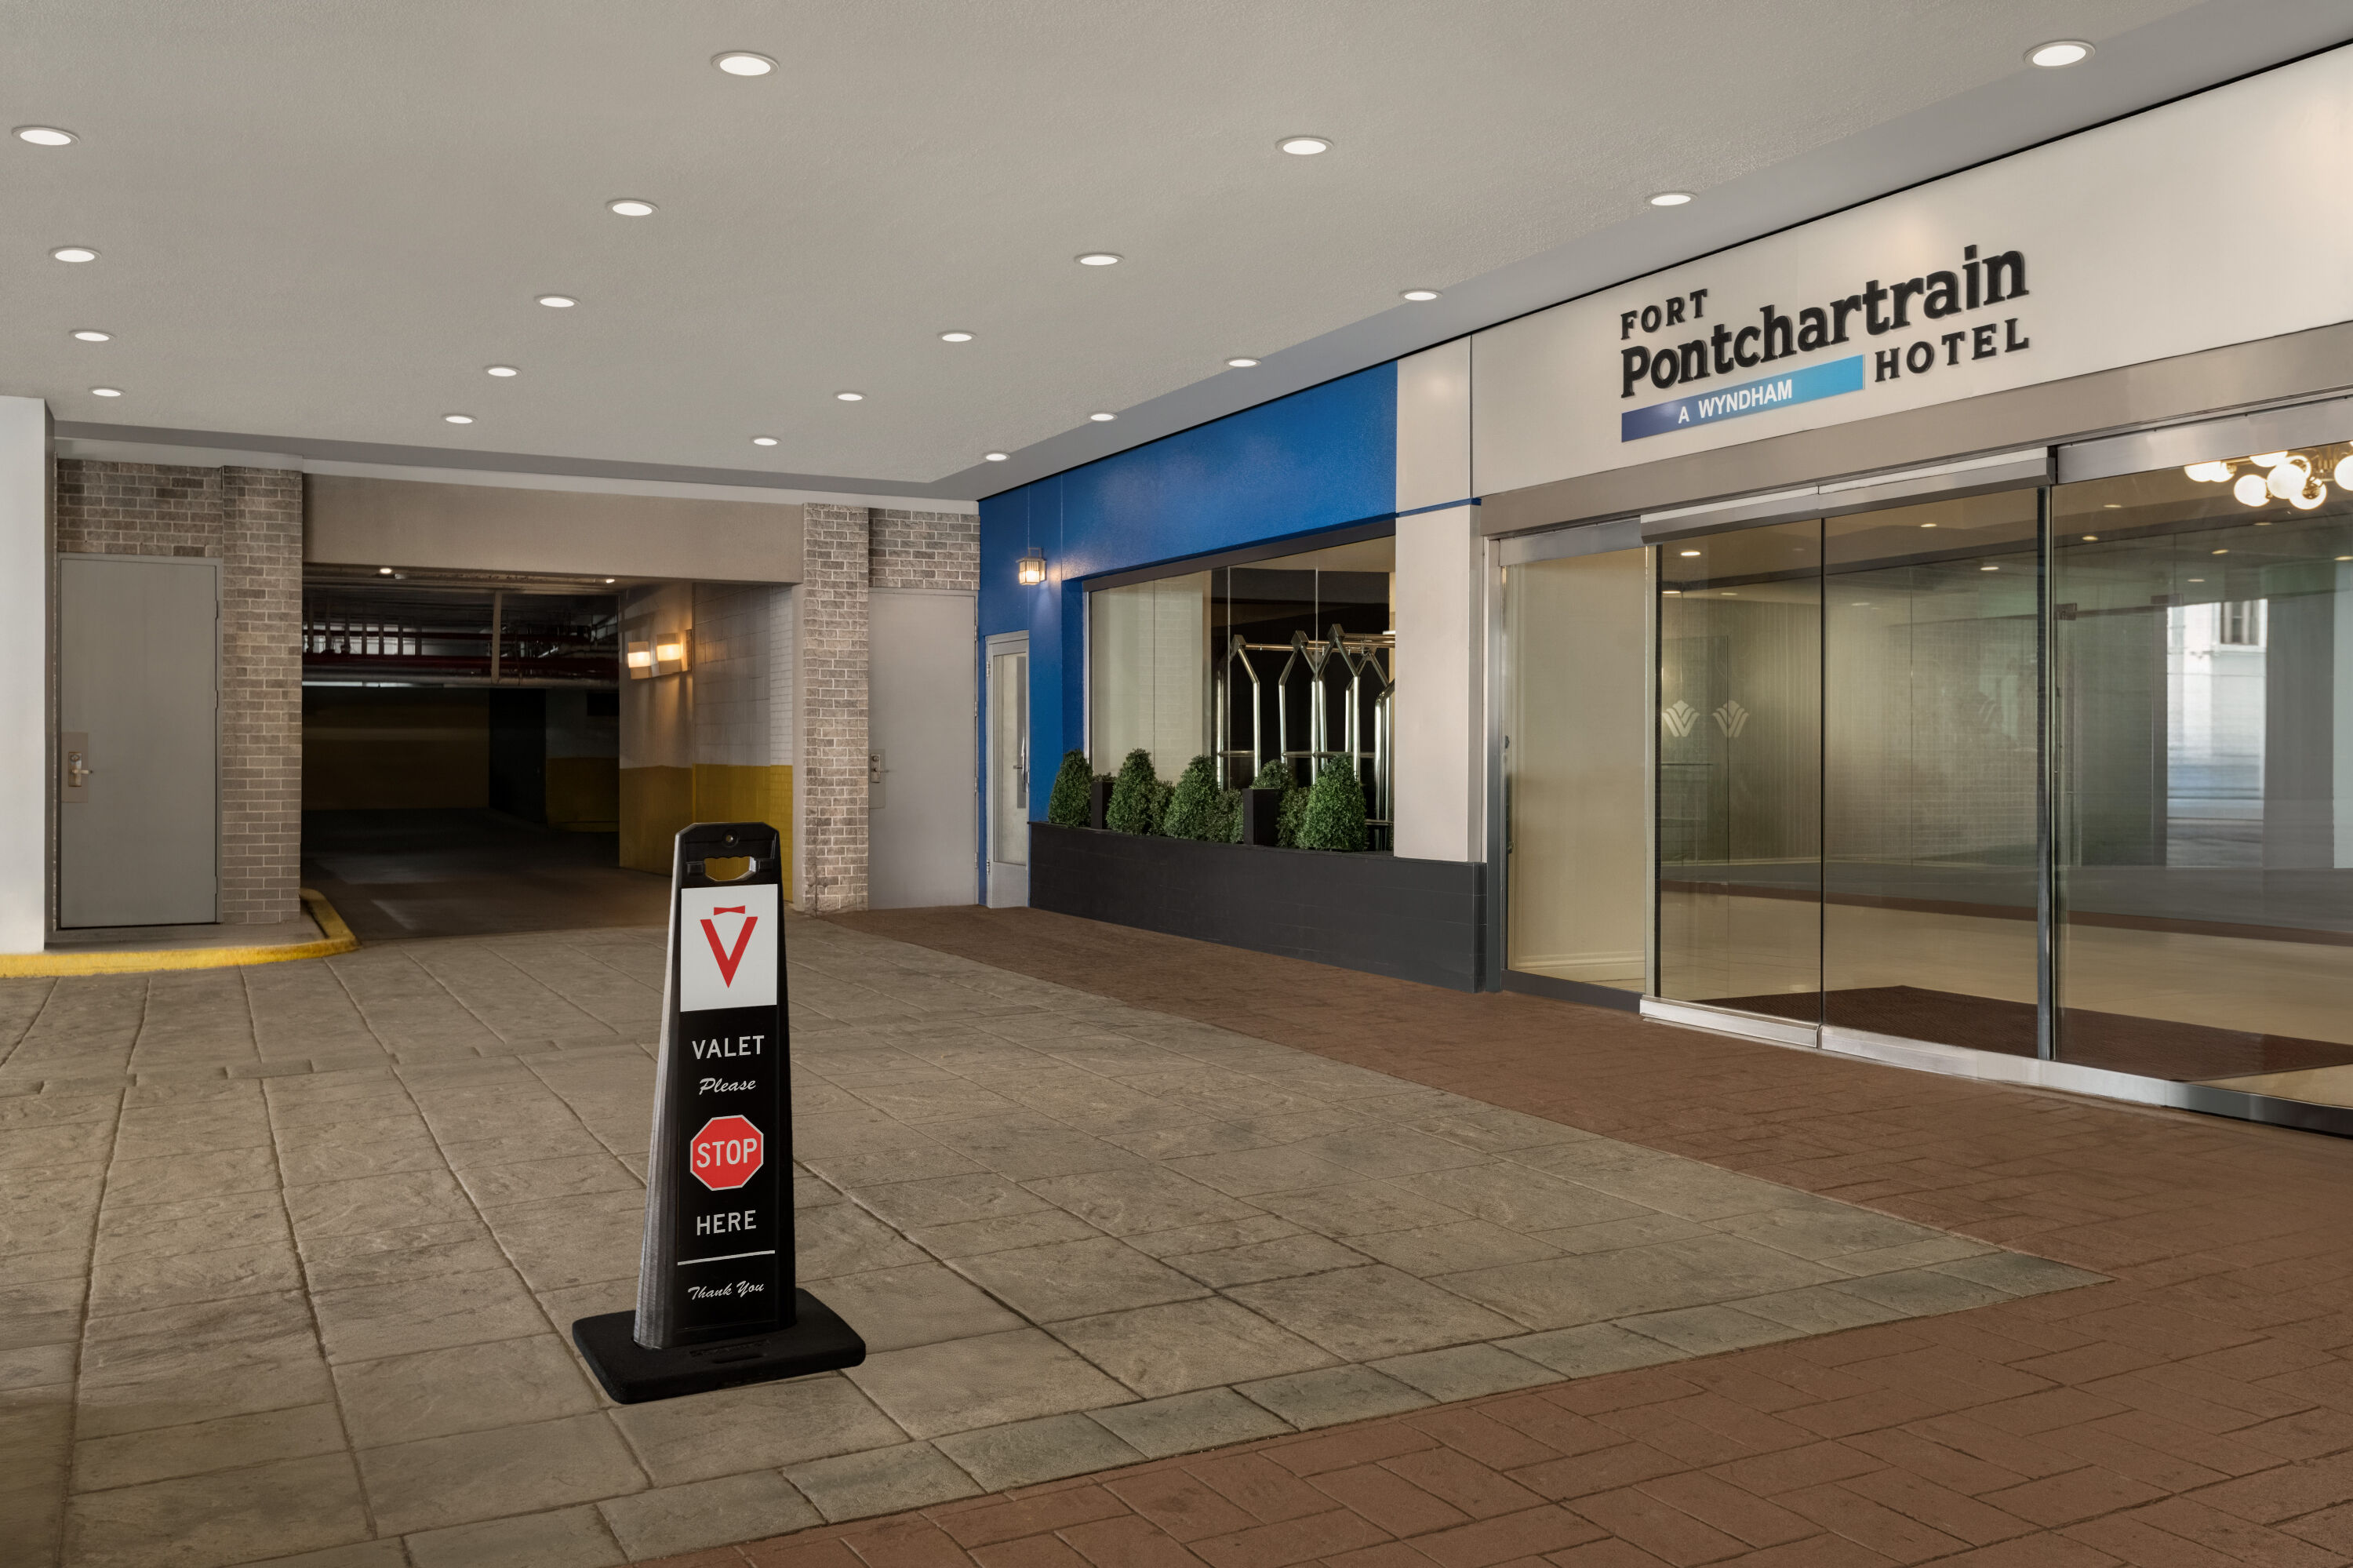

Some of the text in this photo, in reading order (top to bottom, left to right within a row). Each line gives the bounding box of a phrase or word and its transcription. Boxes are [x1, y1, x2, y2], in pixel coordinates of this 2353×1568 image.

[1620, 288, 1707, 340] FORT
[1620, 244, 2029, 398] Pontchartrain
[1875, 318, 2029, 383] HOTEL
[1678, 379, 1793, 424] A WYNDHAM
[692, 1035, 765, 1059] VALET
[699, 1077, 756, 1095] Please
[696, 1137, 758, 1168] STOP
[696, 1210, 757, 1236] HERE
[688, 1280, 765, 1301] Thank You
